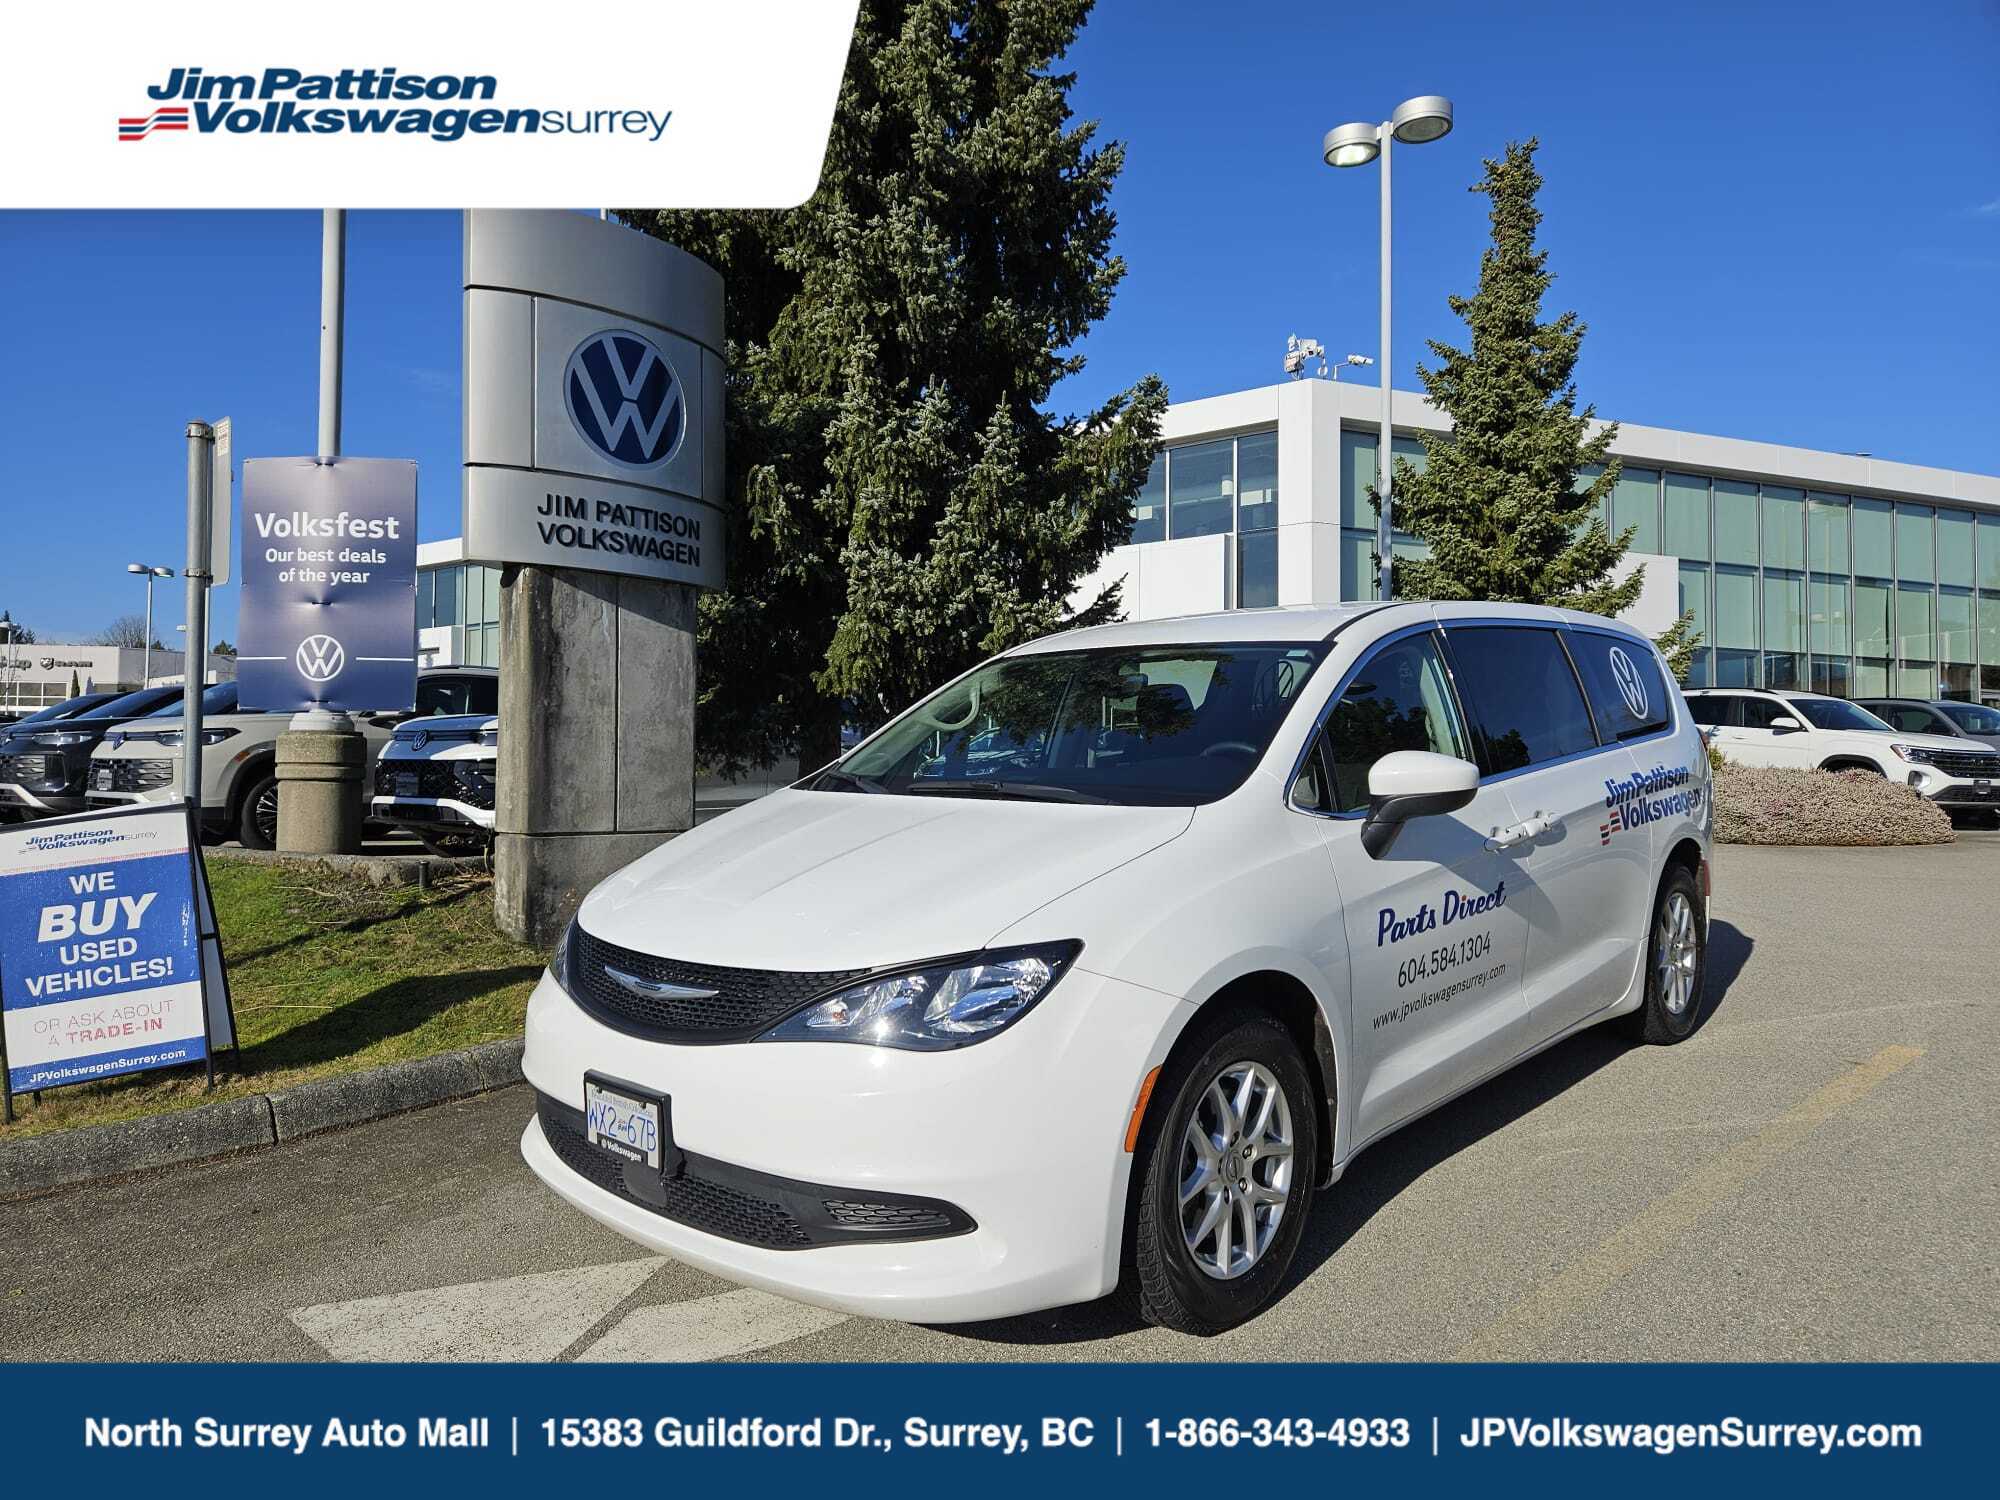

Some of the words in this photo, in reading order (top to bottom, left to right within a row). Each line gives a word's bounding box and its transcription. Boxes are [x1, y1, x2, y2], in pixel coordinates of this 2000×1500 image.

[254, 511, 400, 539] Volksfest
[537, 494, 587, 521] JIM
[596, 500, 700, 541] PATTISON
[265, 548, 294, 562] Our
[297, 547, 334, 562] best
[338, 548, 387, 564] deals
[537, 521, 700, 567] VOLKSWAGEN
[279, 568, 295, 582] of
[299, 568, 326, 582] the
[330, 570, 370, 586] year
[69, 871, 116, 895] WE
[37, 892, 158, 943] BUY
[1378, 904, 1436, 947] Parts
[1442, 881, 1507, 926] Direct
[60, 936, 138, 966] USED
[1398, 931, 1491, 988] 604.584.1304
[25, 956, 174, 997] VEHICLES!
[1373, 963, 1506, 1031] www.jpvolkswagensurrey.com
[34, 1018, 60, 1034] OR
[68, 1009, 106, 1029] ASK
[111, 999, 175, 1021] ABOUT
[48, 1034, 60, 1047] A
[65, 1016, 163, 1045] TRADE-IN
[29, 1048, 186, 1083] JPVolkswagenSurrey.com
[606, 1140, 642, 1162] Volkswagen
